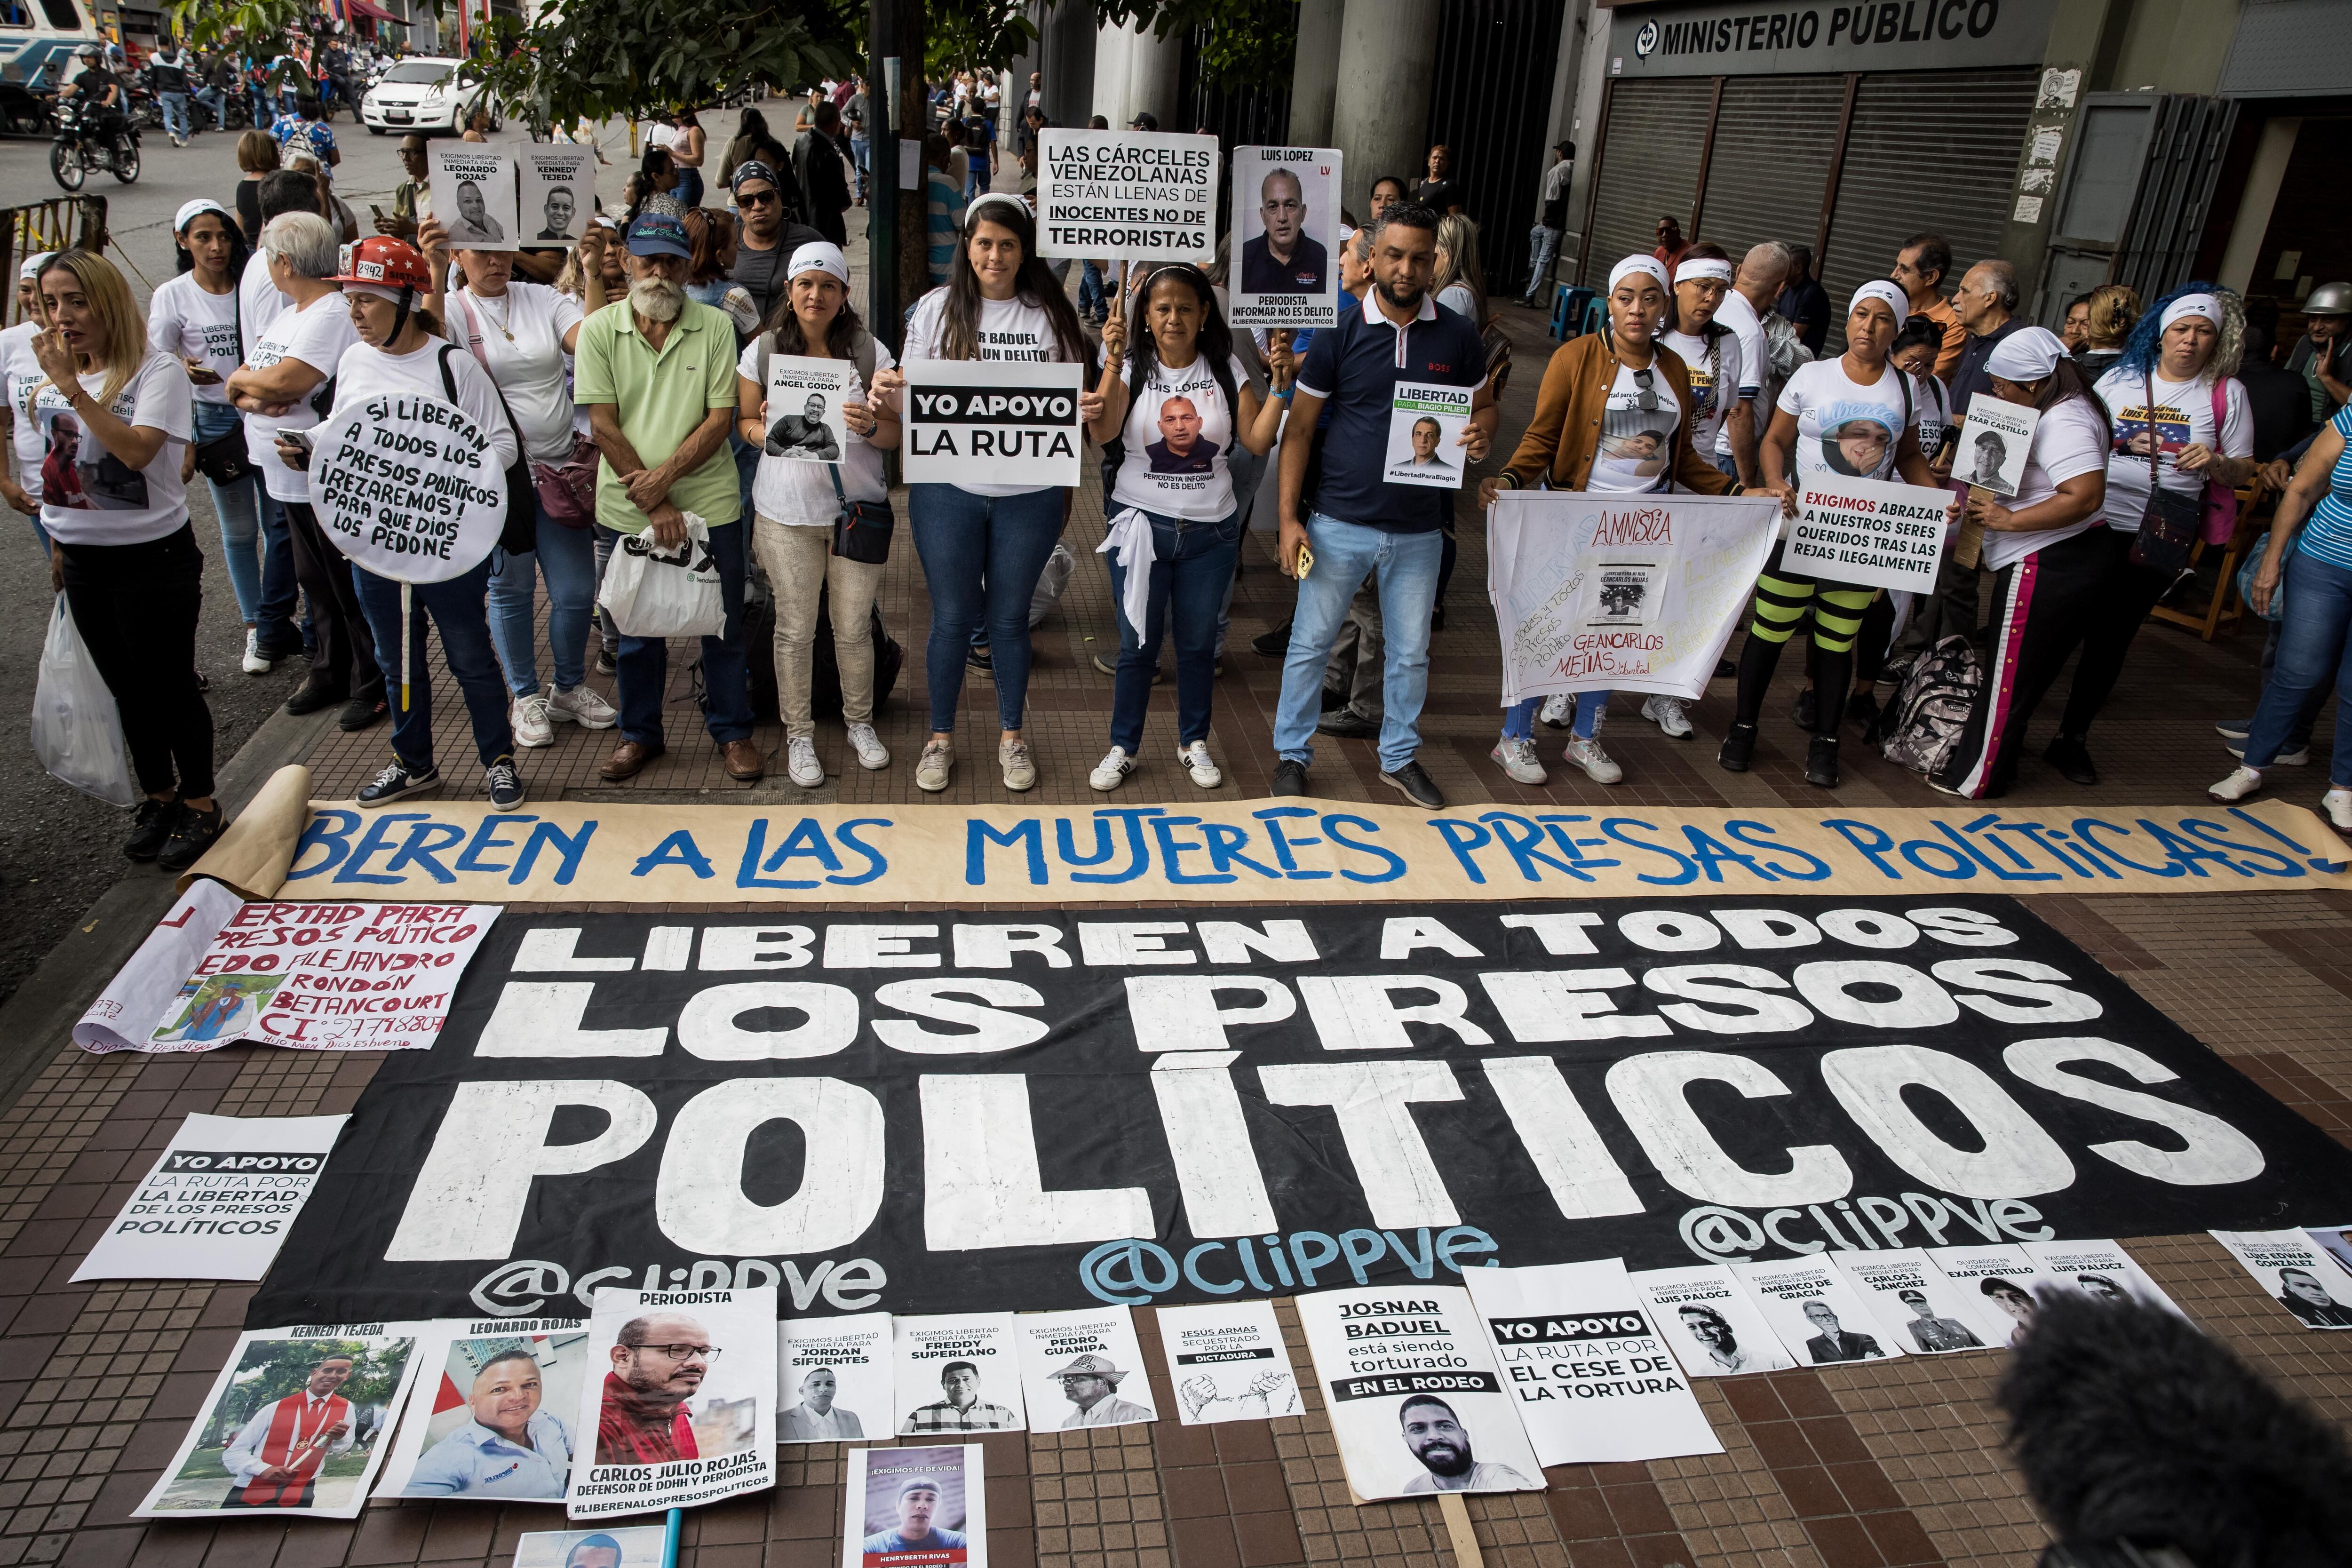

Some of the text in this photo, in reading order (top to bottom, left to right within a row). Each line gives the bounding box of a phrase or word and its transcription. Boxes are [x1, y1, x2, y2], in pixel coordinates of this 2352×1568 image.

[1662, 0, 1999, 56] MINISTERIO PÚBLICO
[1049, 143, 1210, 167] LAS CÁRCELES
[1261, 149, 1313, 162] LUIS LOPEZ
[444, 164, 497, 173] LEONARDO
[1050, 163, 1207, 185] VENEZOLANAS
[1052, 182, 1207, 203] ESTÁN LLENAS DE
[1049, 206, 1206, 223] INOCENTES NO DE
[1049, 227, 1205, 249] TERRORISTAS
[358, 263, 382, 278] 2942
[1259, 296, 1308, 306] PERIODISTA
[1232, 306, 1333, 317] INFORMAR NO ES DELITO
[989, 333, 1038, 345] BADUEL
[1429, 363, 1450, 372] BOSS
[773, 379, 841, 391] ANGEL GODOY
[1175, 379, 1214, 393] LÓPEZ
[1398, 388, 1469, 405] LIBERTAD
[915, 394, 1072, 417] YO APOYO
[1968, 414, 2028, 436] EXAR CASTILLO
[344, 422, 481, 469] A TODOS LOS
[911, 429, 1075, 458] LA RUTA
[336, 444, 421, 486] PRESOS
[1389, 470, 1456, 482] #LibertadParaBiagio
[323, 487, 371, 518] PARA
[379, 507, 412, 531] QUE
[1805, 492, 1943, 522] EXIGIMOS ABRAZAR
[1804, 509, 1936, 539] A NUESTROS SERES
[334, 512, 454, 560] LOS PEDONE
[1797, 525, 1936, 557] QUERIDOS TRAS LAS
[1794, 542, 1932, 574] REJAS ILEGALMENTE
[1573, 633, 1663, 653] GEANCARLOS
[288, 810, 598, 886] BEREN
[631, 829, 716, 878] A
[737, 818, 894, 890] LAS
[965, 806, 1407, 885] MUJERES
[1429, 811, 1832, 885] PRESAS
[372, 905, 467, 925] PARA
[511, 908, 2019, 972] LIBEREN A TODOS
[285, 949, 454, 971] ALEJANDRO
[291, 974, 416, 992] RONDÓN
[269, 991, 449, 1015] BETANCOURT
[475, 958, 2103, 1061] LOS PRESOS
[385, 1037, 2265, 1261] POLÍTICOS
[173, 1155, 318, 1170] YO APOYO
[148, 1175, 310, 1188] LA RUTA POR
[138, 1190, 299, 1202] LA LIBERTAD
[129, 1204, 294, 1214] DE LOS PRESOS
[115, 1217, 282, 1235] POLÍTICOS
[2255, 1258, 2316, 1267] GONZÁLEZ
[1761, 1279, 1833, 1294] AMÉRICO DE
[1864, 1274, 1908, 1284] CARLOS
[1872, 1276, 1928, 1291] SÁNCHEZ
[639, 1291, 732, 1305] PERIODISTA
[1653, 1289, 1732, 1304] LUIS PALOCZ
[1779, 1289, 1825, 1300] GRACIA
[1339, 1300, 1441, 1316] JOSNAR
[1181, 1326, 1257, 1337] JESÚS ARMAS
[1344, 1320, 1450, 1337] BADUEL
[926, 1340, 982, 1350] FREDDY
[1050, 1336, 1098, 1346] PEDRO
[1183, 1335, 1260, 1346] SECUESTRADO
[1348, 1340, 1454, 1356] está siendo
[801, 1347, 860, 1356] JORDAN
[911, 1348, 997, 1359] SUPERLANO
[1044, 1343, 1108, 1355] GUANIPA
[1195, 1351, 1257, 1362] DICTADURA
[792, 1356, 869, 1366] SIFUENTES
[1350, 1353, 1468, 1373] torturado
[1350, 1377, 1485, 1395] EN EL RODEO
[590, 1450, 757, 1482] CARLOS JULIO ROJAS
[871, 1467, 913, 1476] ¡EXIGIMOS
[574, 1475, 768, 1513] #LIBERENALOSPRESOSPOLITICOS
[880, 1554, 927, 1562] HENRYBERTH
